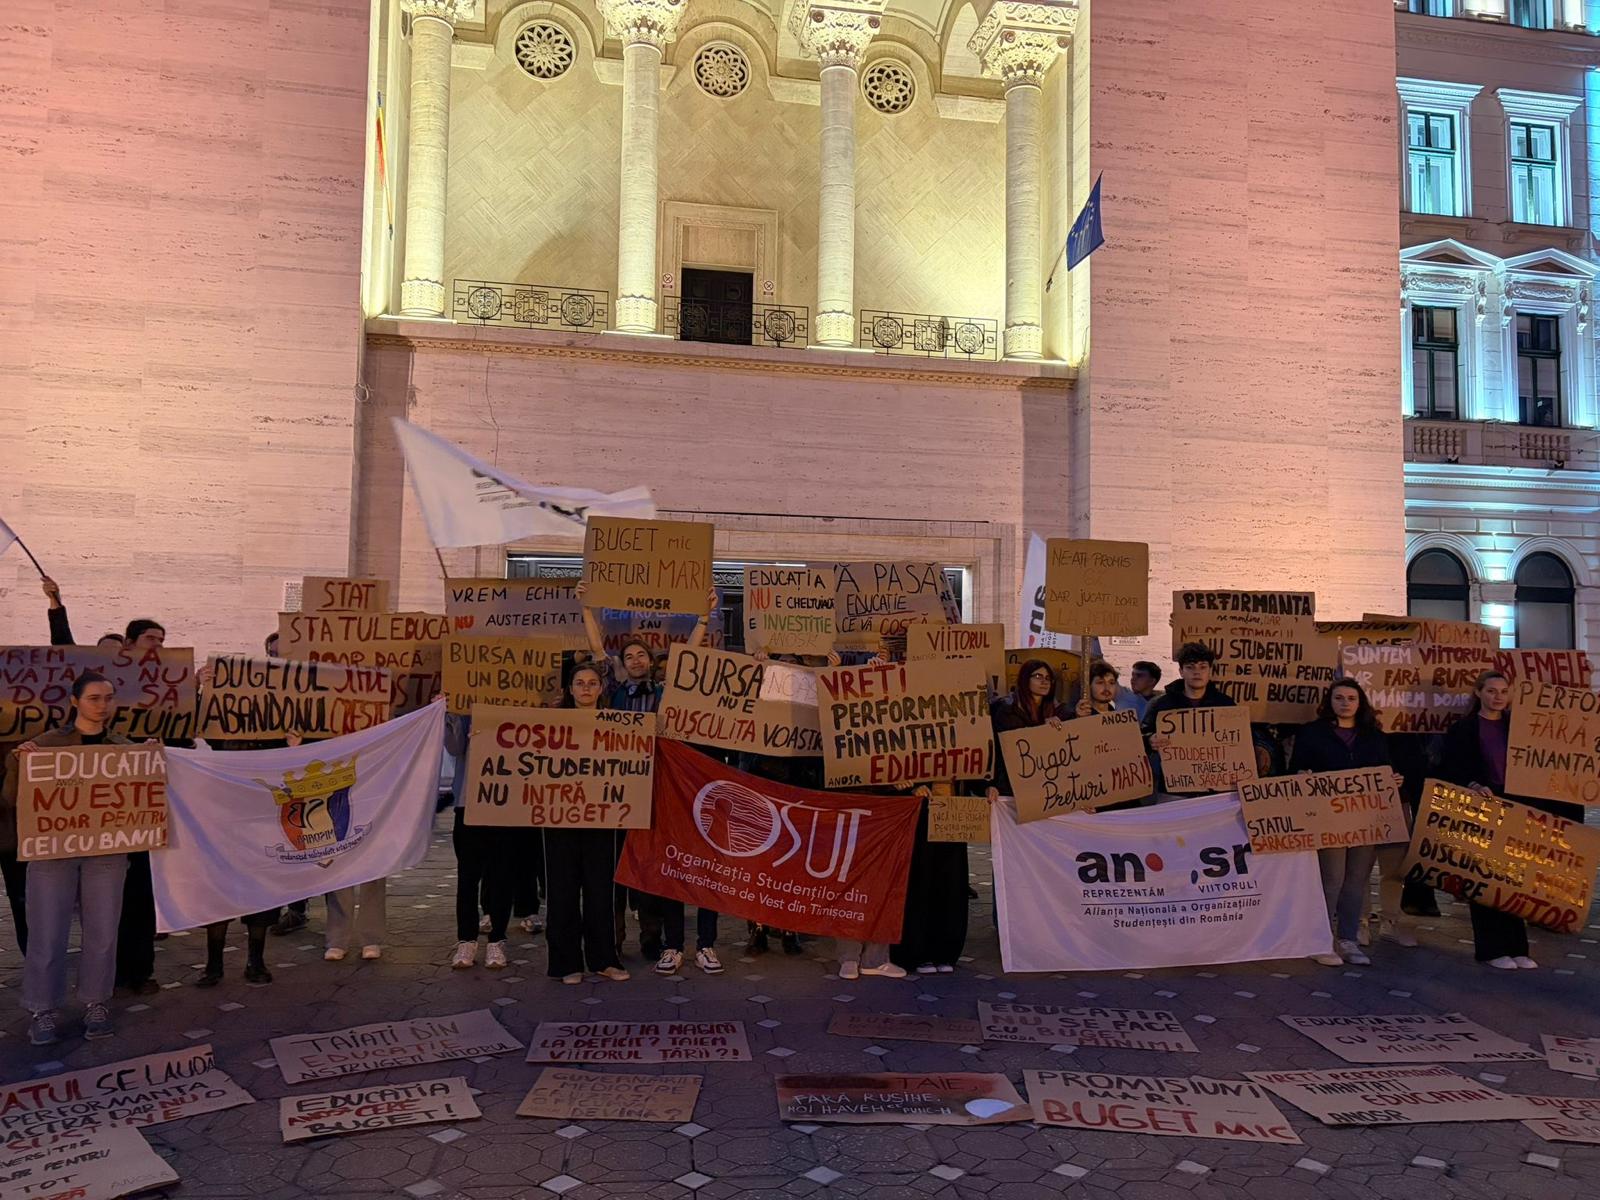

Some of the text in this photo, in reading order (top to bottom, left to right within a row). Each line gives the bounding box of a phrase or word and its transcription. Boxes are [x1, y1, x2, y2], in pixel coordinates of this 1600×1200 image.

[592, 528, 658, 552] BUGET
[657, 558, 706, 591] MARI
[874, 562, 939, 594] PASĂ
[324, 581, 376, 609] STAT
[452, 587, 507, 602] VREM
[626, 597, 671, 610] ANOSR
[750, 587, 782, 611] NU E
[454, 614, 474, 631] NU
[638, 620, 661, 630] SAU
[749, 617, 757, 629] E
[927, 627, 991, 651] VIITORUL
[450, 642, 561, 669] BURSA NU E
[1230, 639, 1303, 664] STUDENȚII
[1342, 645, 1492, 666] SUNTEM VIITORUL
[138, 667, 188, 685] NU
[466, 670, 491, 688] UN
[673, 650, 764, 699] BURSA
[821, 660, 907, 701] VREȚI
[1236, 663, 1252, 676] DE
[1259, 663, 1287, 679] VINĂ
[203, 692, 328, 735] ABANDONUL
[717, 695, 755, 714] NU E
[596, 712, 645, 726] ANOSR
[1102, 710, 1138, 726] ANOSR
[497, 722, 579, 754] COȘUL
[1528, 710, 1588, 748] FĂRĂ
[481, 755, 512, 776] AL
[1016, 733, 1081, 781] Buget
[1233, 762, 1246, 771] LA
[829, 775, 861, 786] ANOSR
[1042, 755, 1152, 812] Prețuri MARI!
[1242, 779, 1302, 802] EDUCAȚIA
[34, 782, 166, 812] NU ESTE
[477, 782, 509, 805] NU
[603, 781, 625, 803] ÎN
[38, 814, 90, 832] DOAR
[1248, 816, 1304, 838] STATUL
[22, 837, 56, 857] CEI
[64, 834, 94, 853] CU
[665, 845, 869, 905] Organizația Studenților din
[660, 863, 865, 922] Universitatea de Vest din Timișoara
[1083, 880, 1258, 898] REPREZENTĂM VIITORUL!
[1084, 906, 1124, 917] Alianța
[1128, 905, 1177, 917] Națională
[1191, 898, 1261, 913] Organizațiilor
[1113, 912, 1244, 928] Studențești din România
[992, 1015, 1184, 1033] NU SE FACE
[1397, 1015, 1427, 1025] NU
[1434, 1014, 1467, 1024] SE
[411, 1021, 460, 1041] DIN
[986, 1024, 1018, 1034] CU
[1036, 1026, 1131, 1039] BUGET
[1335, 1032, 1479, 1045] CU BUGET
[1355, 1026, 1415, 1034] FACE
[541, 1037, 566, 1048] LA
[1376, 1042, 1453, 1054] MINIM
[550, 1048, 643, 1060] VIITORUL
[1472, 1052, 1547, 1061] ANOSR
[97, 1069, 136, 1095] SE
[1037, 1071, 1259, 1098] PROMISIUNI
[109, 1089, 227, 1121] DAR NU O
[354, 1099, 424, 1118] CERE
[1042, 1099, 1295, 1140] BUGET MIC
[1328, 1110, 1413, 1125] ANOSR
[44, 1149, 111, 1172] PENTRU
